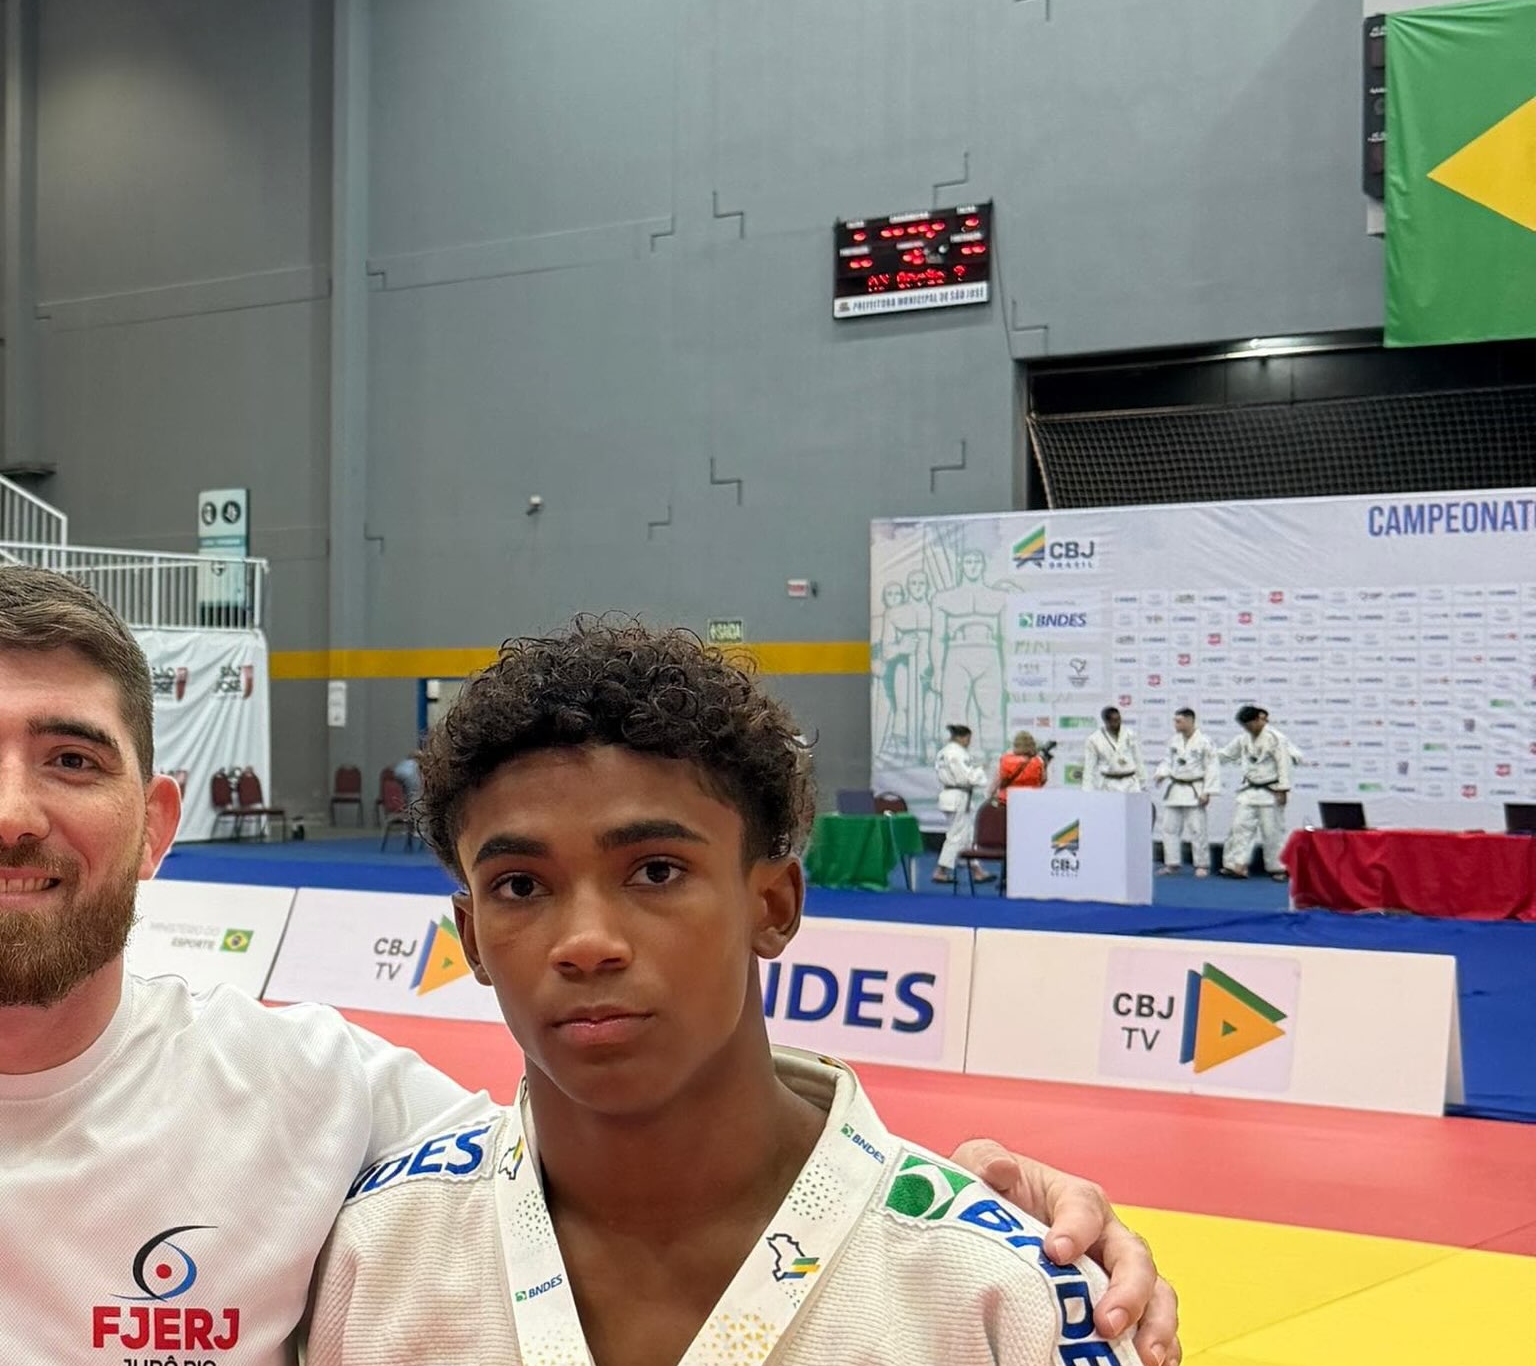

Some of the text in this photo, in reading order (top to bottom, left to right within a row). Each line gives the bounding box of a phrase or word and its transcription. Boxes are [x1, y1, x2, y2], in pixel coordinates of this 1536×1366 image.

[1369, 500, 1536, 537] CAMPEONAT
[1049, 540, 1095, 560] CBJ
[1036, 612, 1088, 628] BNDES
[373, 937, 418, 957] CBJ
[375, 962, 402, 981] TV
[1113, 992, 1175, 1020] CBJ
[1121, 1026, 1161, 1052] TV
[852, 1133, 886, 1165] BNDES
[528, 1273, 563, 1299] BNDES
[93, 1306, 240, 1351] FJERJ
